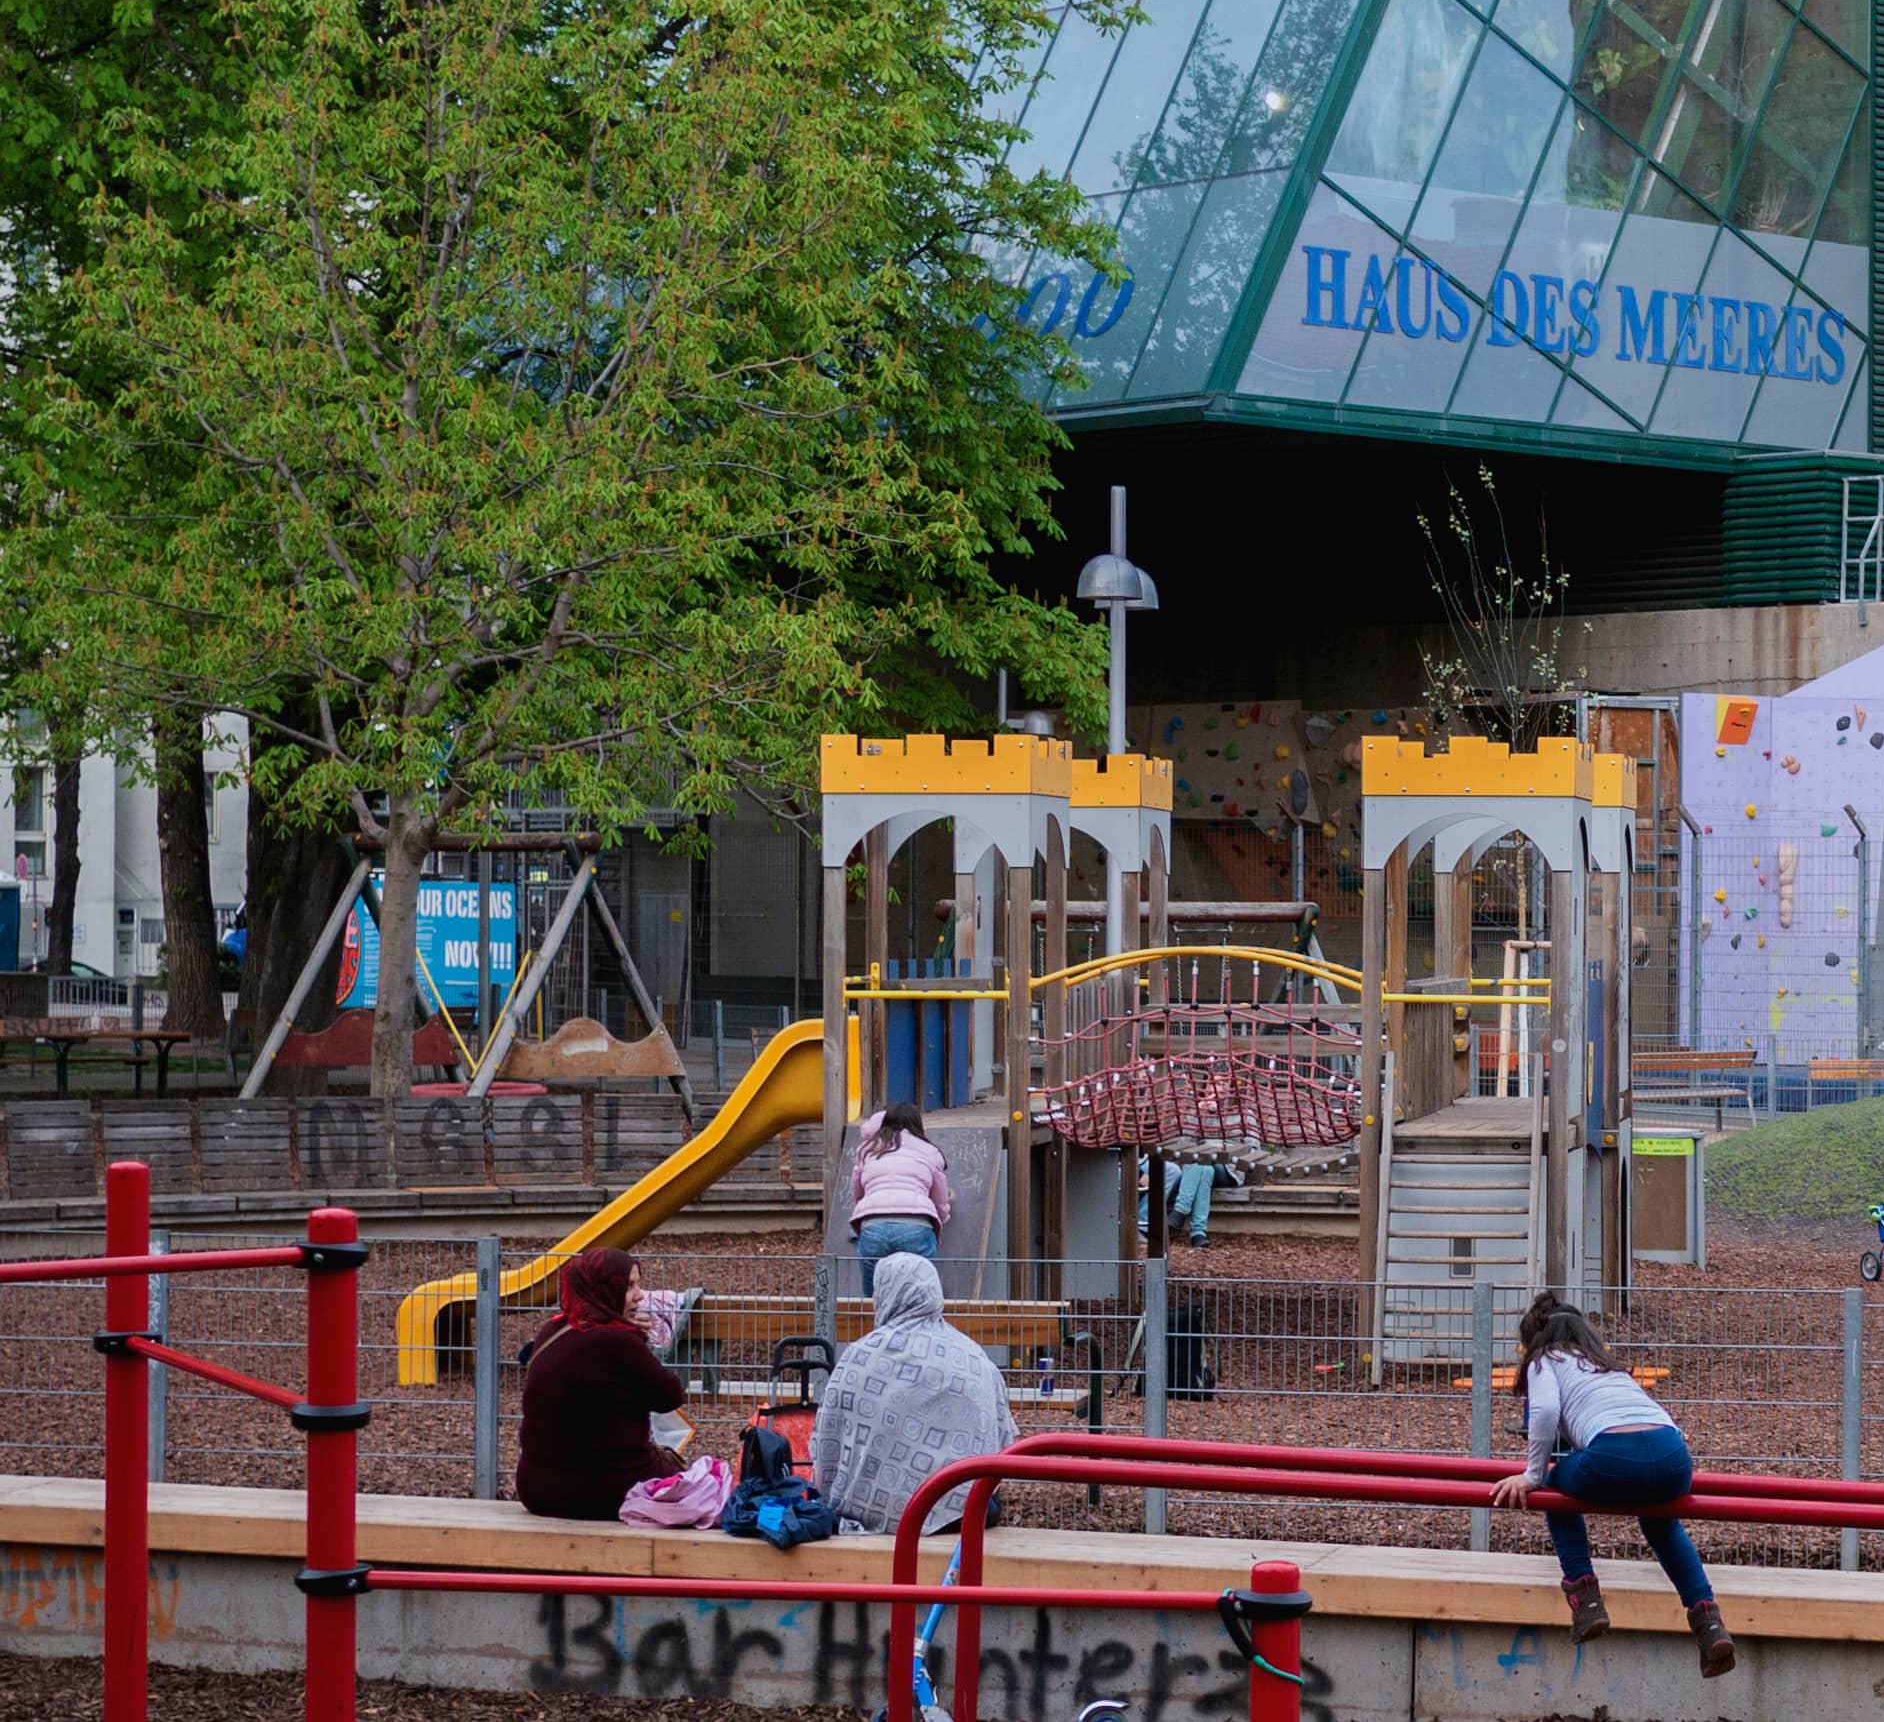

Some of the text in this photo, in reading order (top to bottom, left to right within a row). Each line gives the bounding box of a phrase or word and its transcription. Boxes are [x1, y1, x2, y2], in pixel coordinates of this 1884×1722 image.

[1300, 246, 1847, 385] HAUS DES MEERES
[416, 888, 513, 920] UR OCENS
[530, 1592, 784, 1700] Bar
